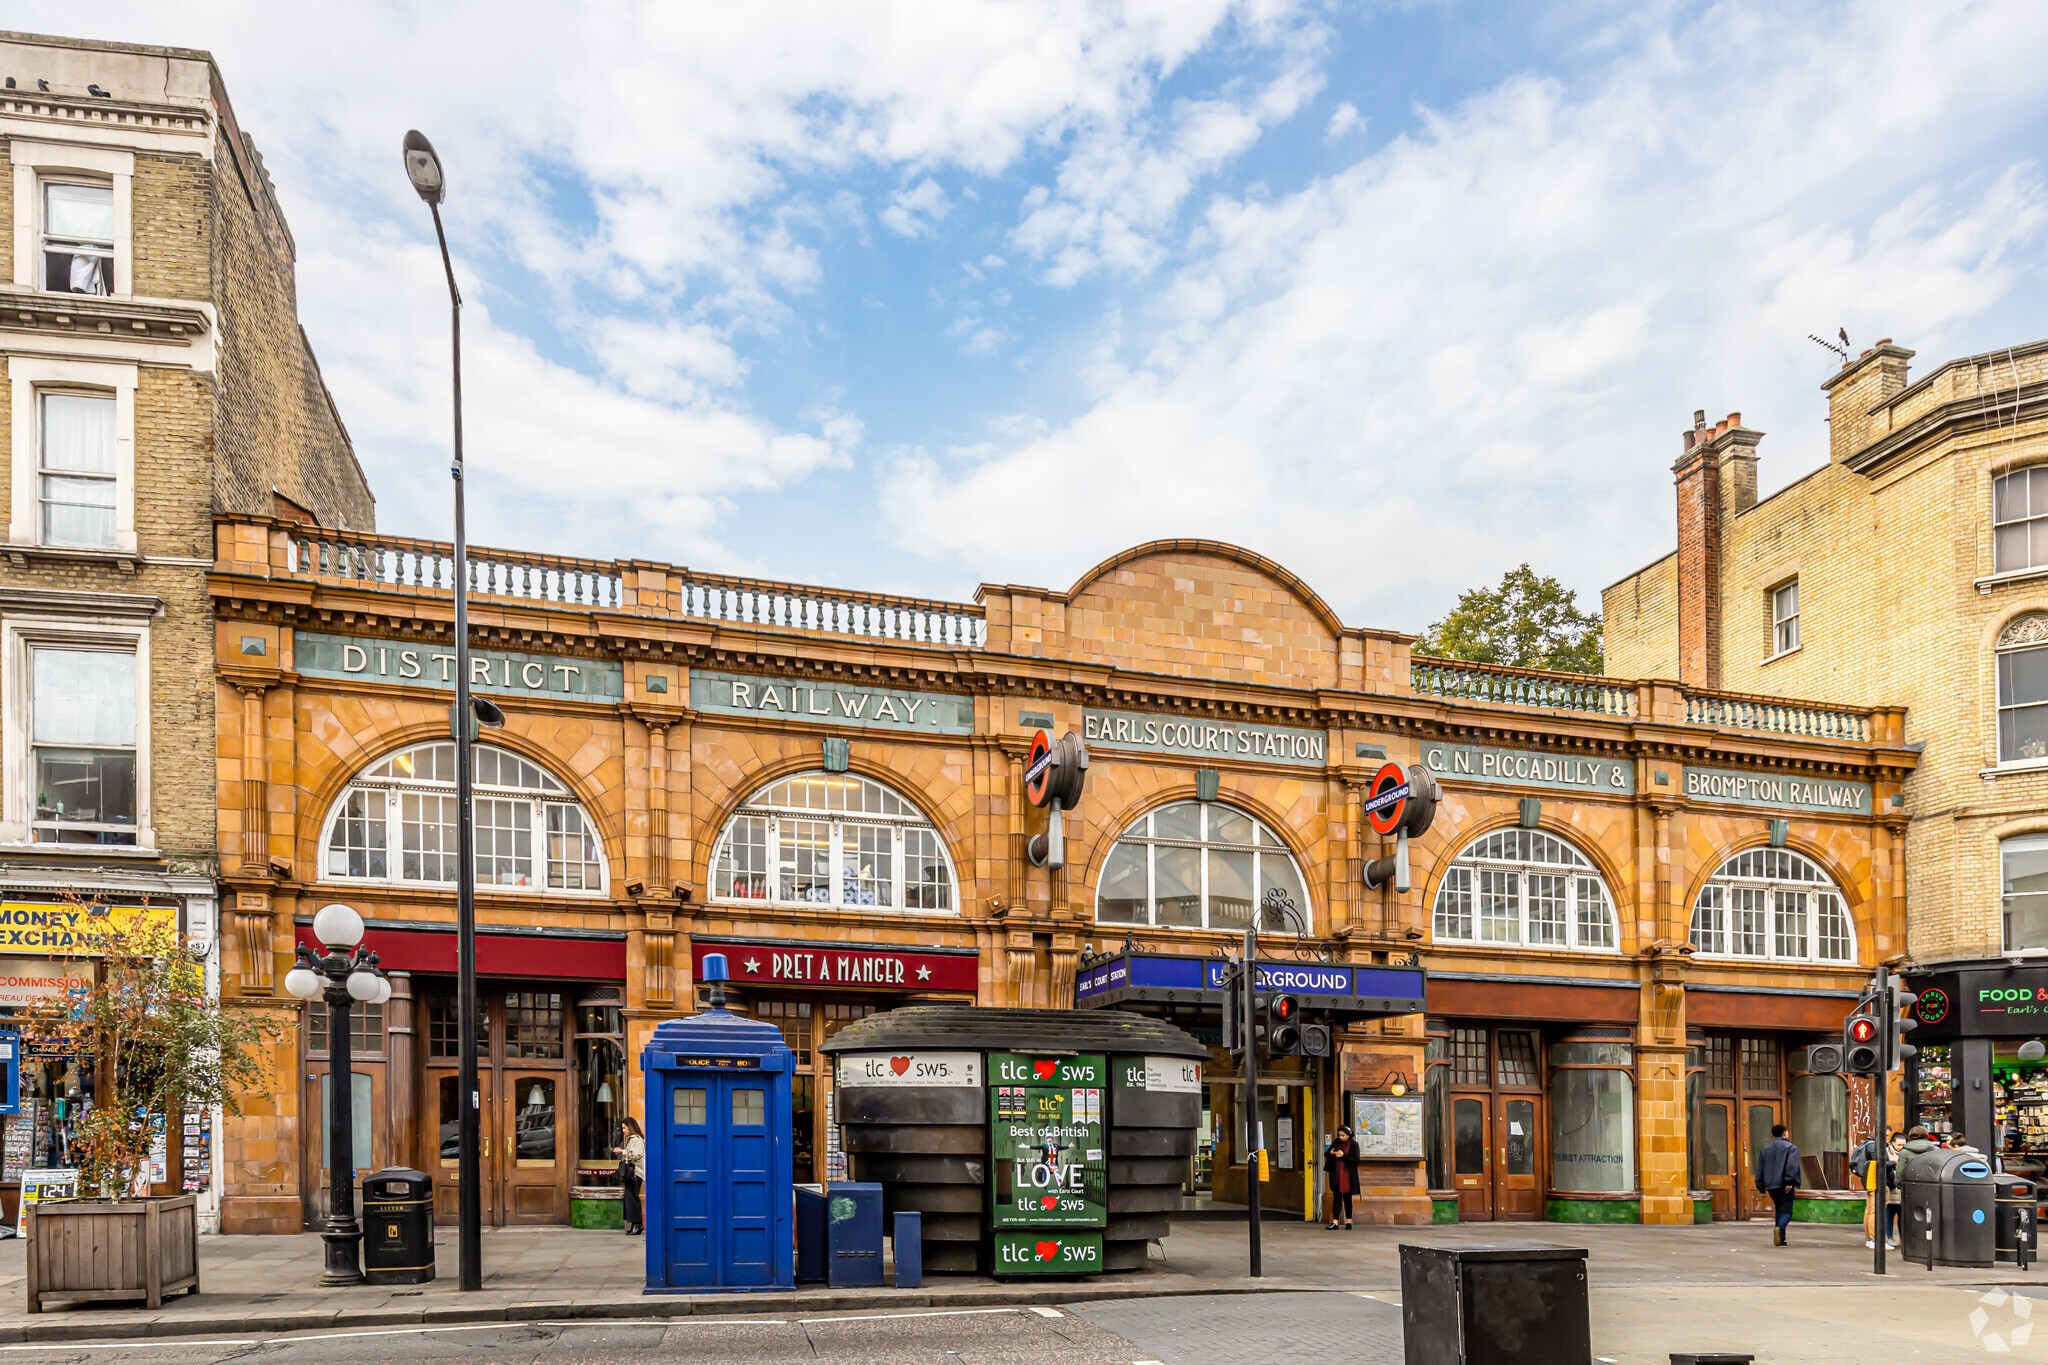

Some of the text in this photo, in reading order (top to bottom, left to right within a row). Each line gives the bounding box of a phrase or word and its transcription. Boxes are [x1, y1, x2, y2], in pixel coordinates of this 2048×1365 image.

[342, 644, 580, 692] DISTRICT
[1084, 715, 1324, 760] EARLS COURT STATION
[1025, 753, 1052, 782] UNDERGROUND
[1427, 749, 1626, 788] G. N. PICCADILLY &
[1365, 786, 1409, 811] UNDERGROUND
[1687, 773, 1865, 809] BROMPTON RAILWAY
[0, 910, 80, 926] MONEY
[0, 930, 126, 948] EXCHANE
[772, 953, 905, 984] PRET A MANGER
[1094, 974, 1108, 987] COURT
[1110, 968, 1127, 981] STATION
[1212, 968, 1347, 989] URGROUND
[1921, 991, 1944, 1003] EARL'S
[1979, 987, 2048, 1001] FOOD &
[1920, 1009, 1944, 1021] COURT
[2007, 1005, 2039, 1014] Earl's
[865, 1059, 948, 1077] tlc SW5
[1000, 1061, 1095, 1081] tlc SW5
[1126, 1066, 1145, 1082] tlc
[1181, 1064, 1193, 1082] tlc
[1039, 1097, 1057, 1111] tlc
[1010, 1125, 1089, 1137] Best of British
[1578, 1154, 1624, 1164] ATTRACTION
[1017, 1163, 1084, 1188] LOVE
[1017, 1197, 1085, 1211] tlc SW5
[1002, 1243, 1096, 1262] tlc SW5
